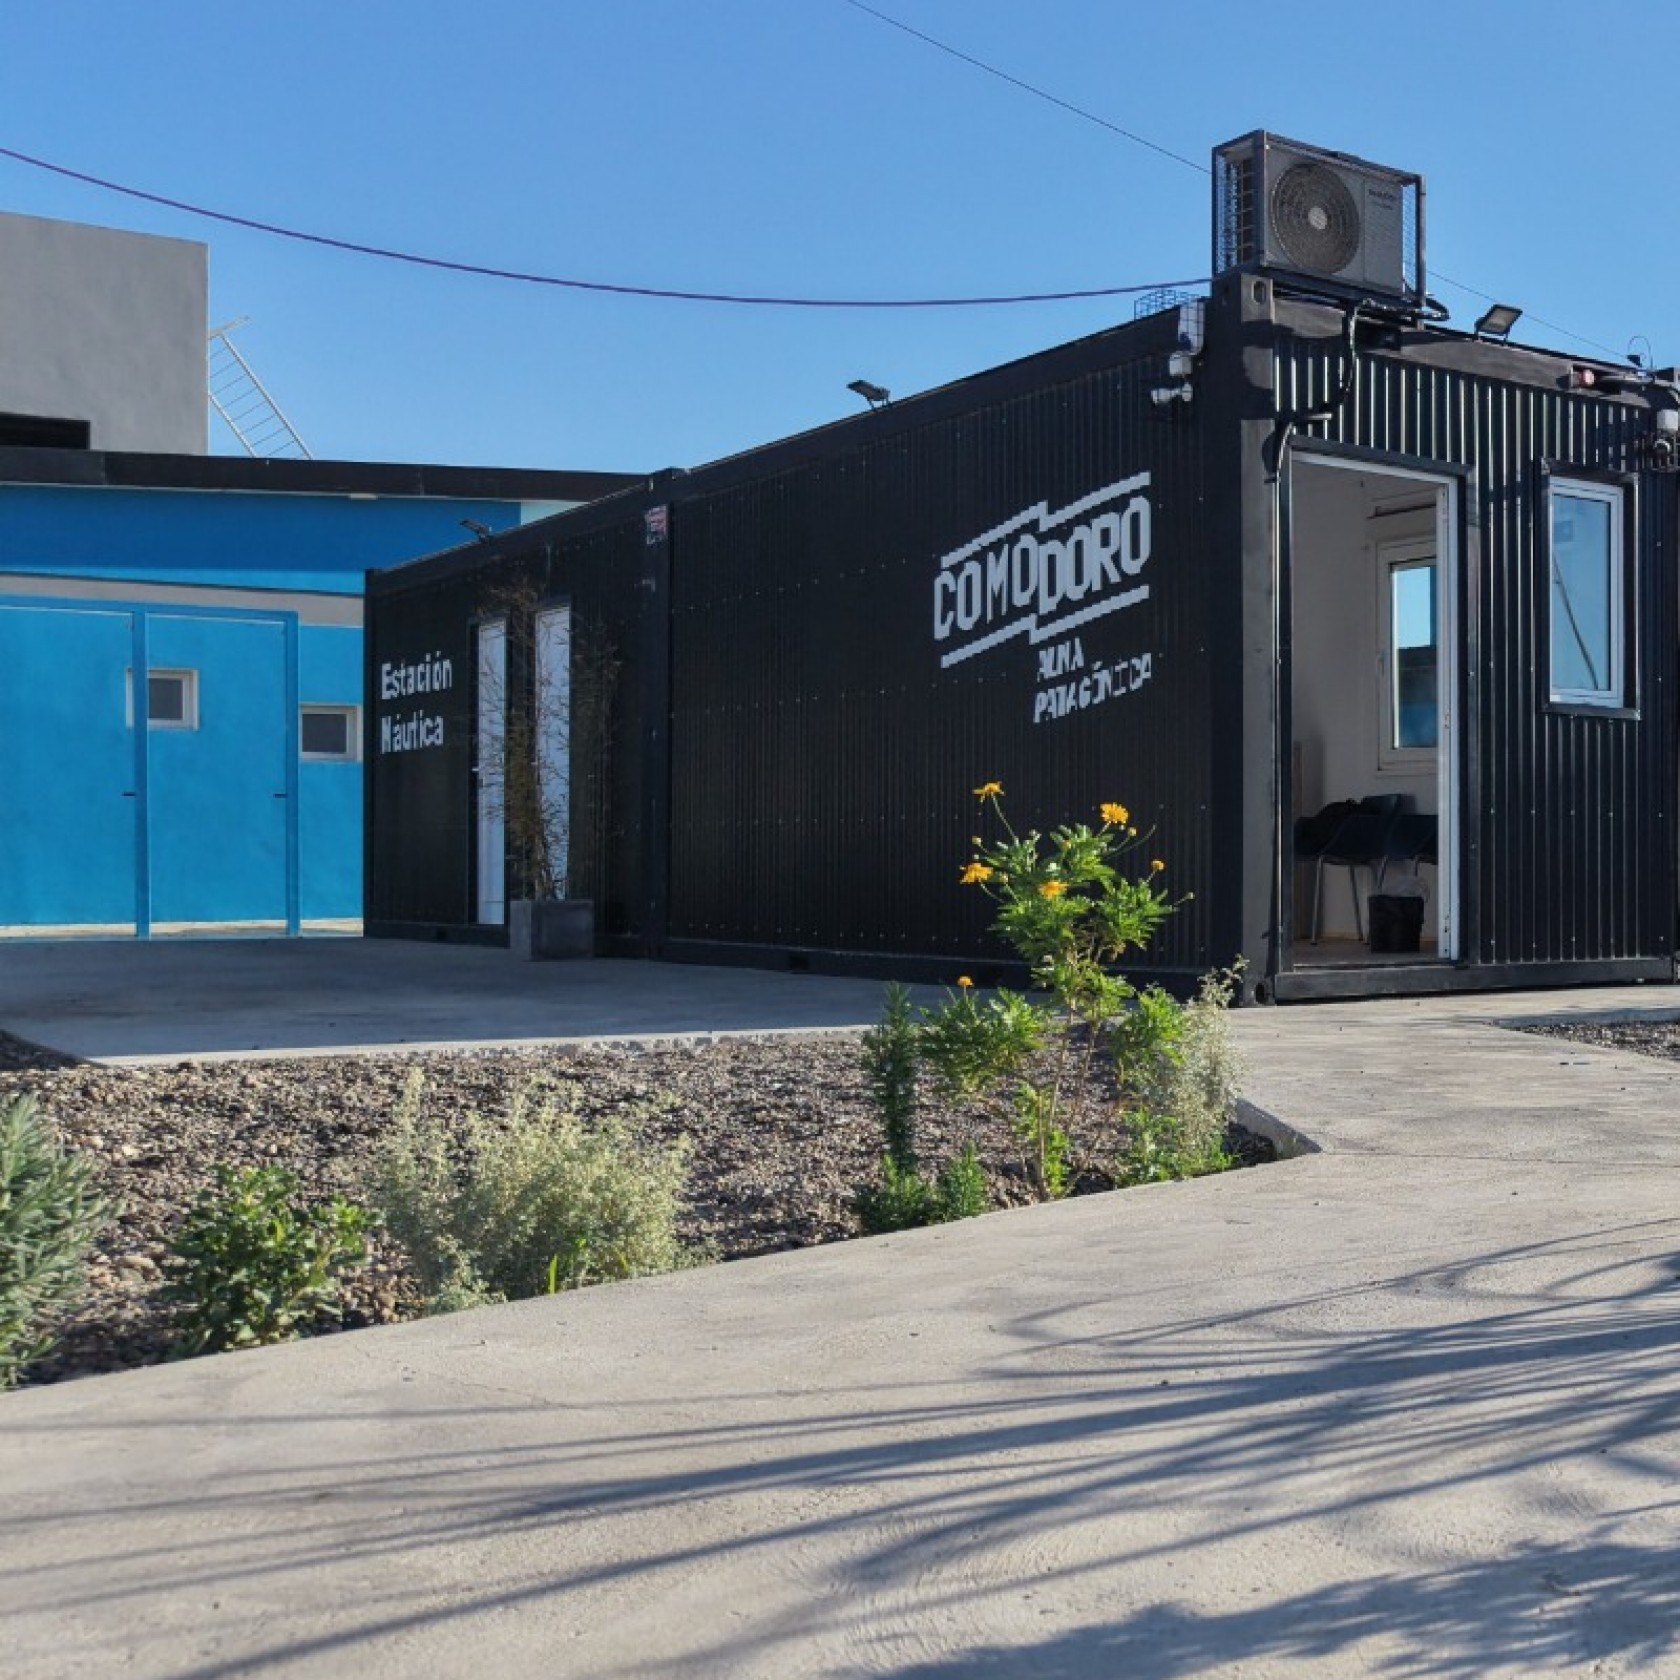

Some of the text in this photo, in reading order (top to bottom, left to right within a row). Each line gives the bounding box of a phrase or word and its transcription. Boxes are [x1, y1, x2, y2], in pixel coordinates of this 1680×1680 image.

[933, 495, 1151, 641] COMODORO
[381, 650, 453, 700] Estación
[1032, 652, 1152, 723] PATAGÓNICA
[381, 709, 444, 754] Náutica
